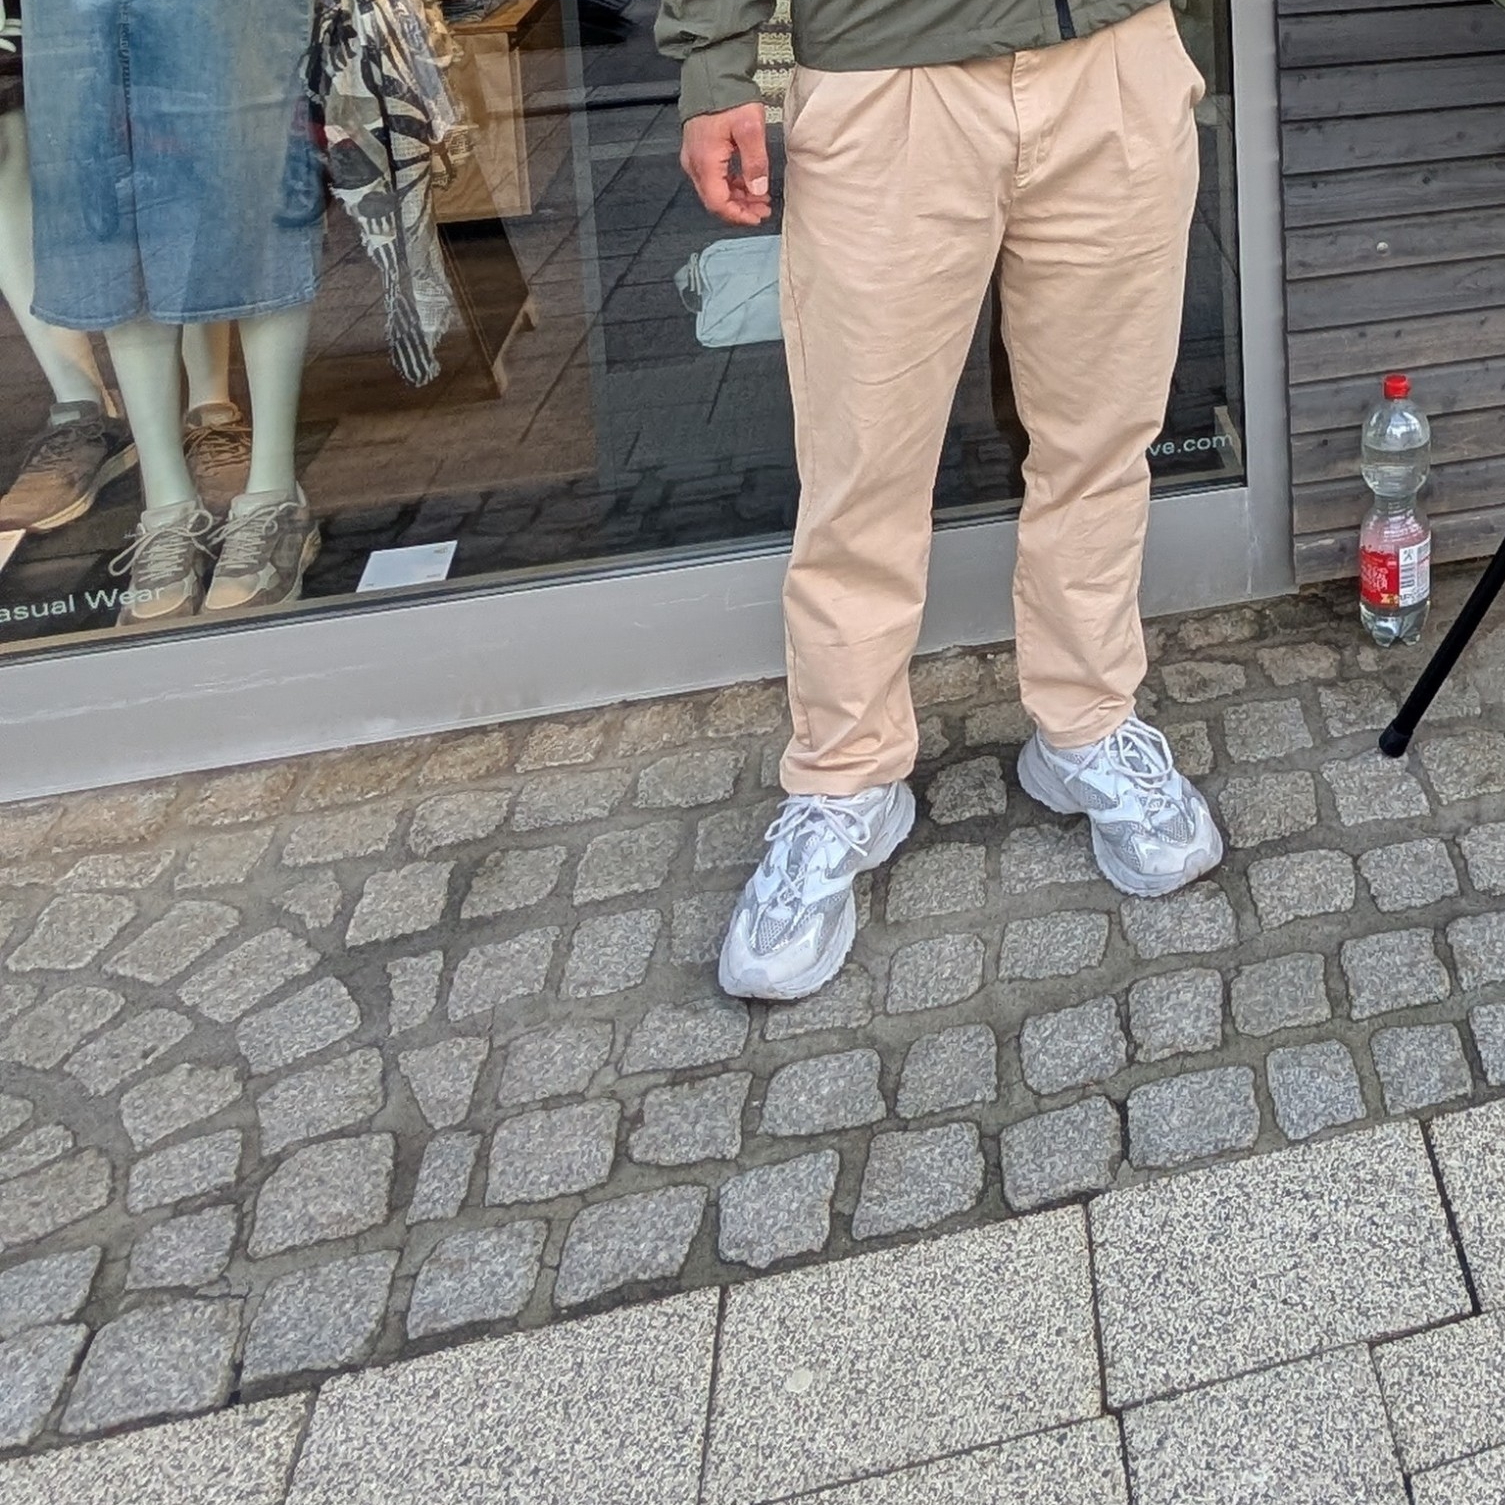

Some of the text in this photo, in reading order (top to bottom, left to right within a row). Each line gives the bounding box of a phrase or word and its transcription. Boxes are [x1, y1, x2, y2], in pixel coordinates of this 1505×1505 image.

[1148, 433, 1233, 457] ve.com
[0, 586, 165, 623] asual Wear
